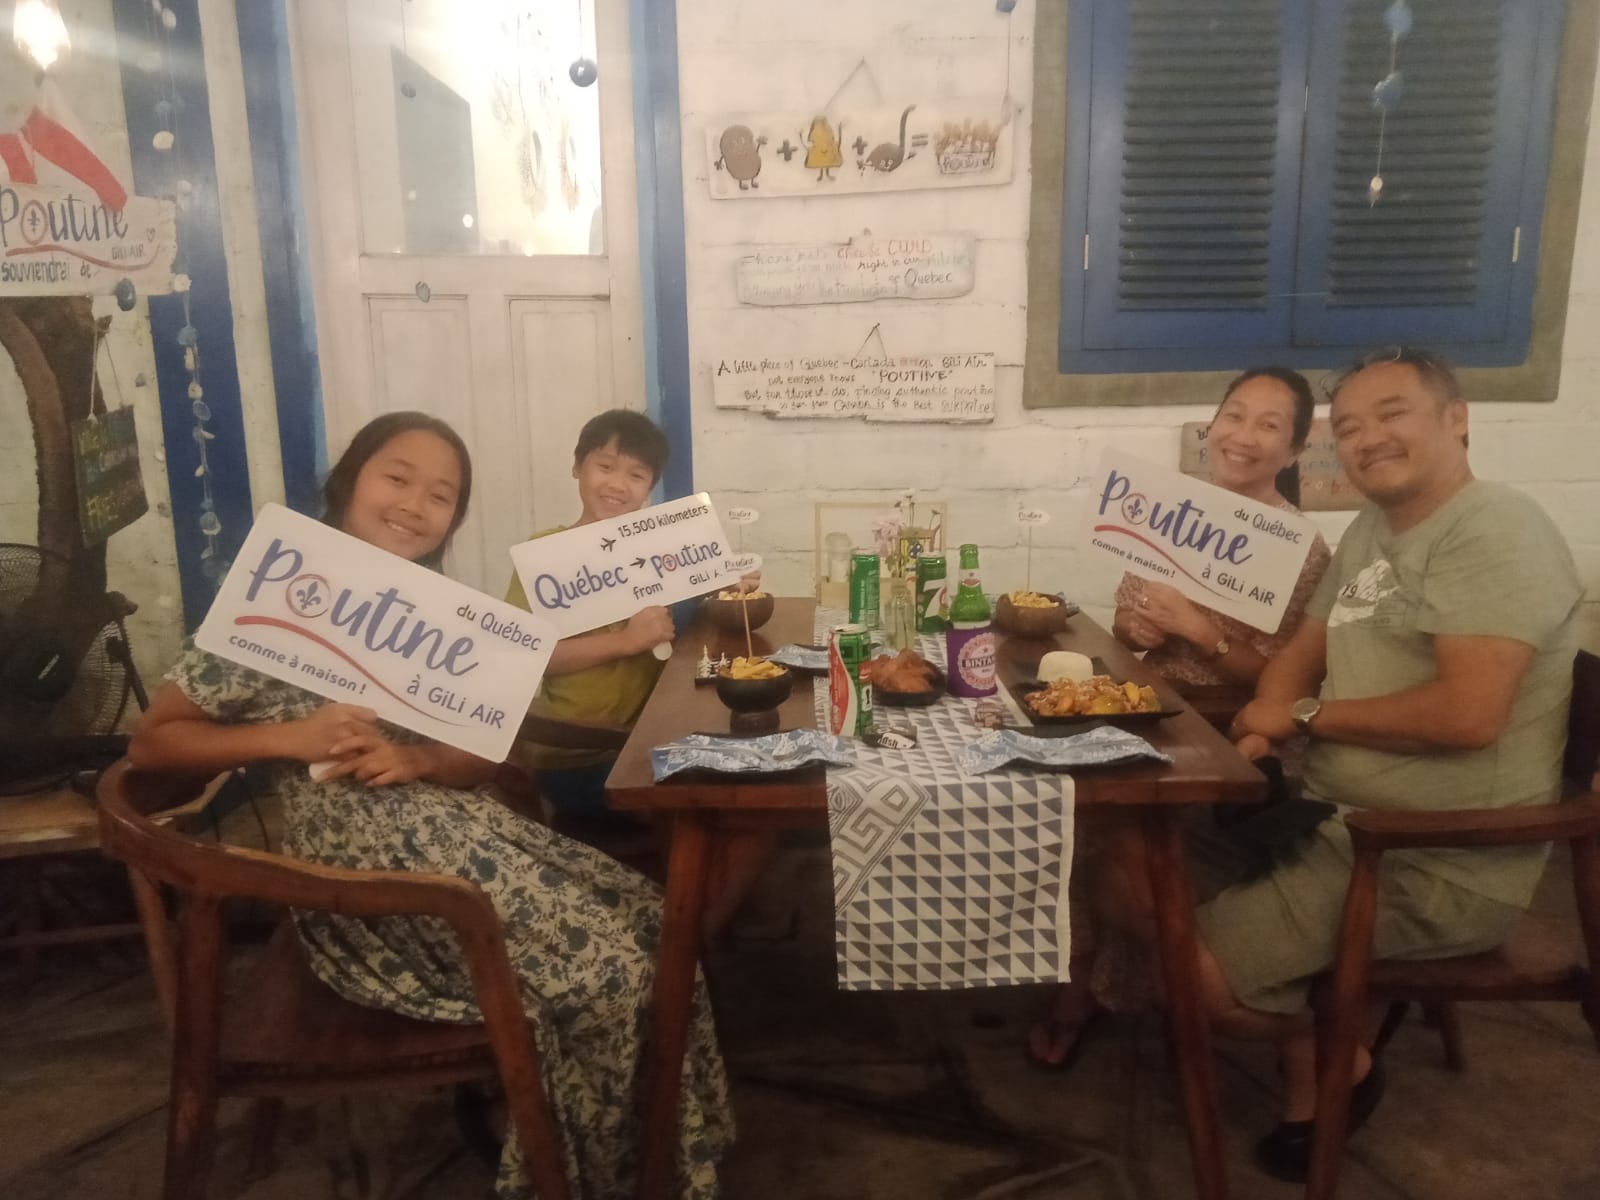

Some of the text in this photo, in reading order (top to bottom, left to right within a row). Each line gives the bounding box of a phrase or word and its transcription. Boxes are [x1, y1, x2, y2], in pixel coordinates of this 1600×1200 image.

[717, 360, 731, 376] A
[658, 504, 709, 527] kilometers
[1098, 470, 1252, 565] Poutine
[1234, 508, 1302, 544] du Québec
[1092, 537, 1125, 559] comme
[1134, 555, 1169, 577] maison
[1202, 563, 1211, 579] à
[535, 565, 628, 609] Québec
[633, 581, 663, 600] from
[246, 539, 479, 676] Poutine
[456, 604, 542, 651] du Québec
[229, 634, 286, 664] comme
[288, 655, 298, 668] à
[301, 661, 357, 692] maison
[406, 674, 418, 696] à
